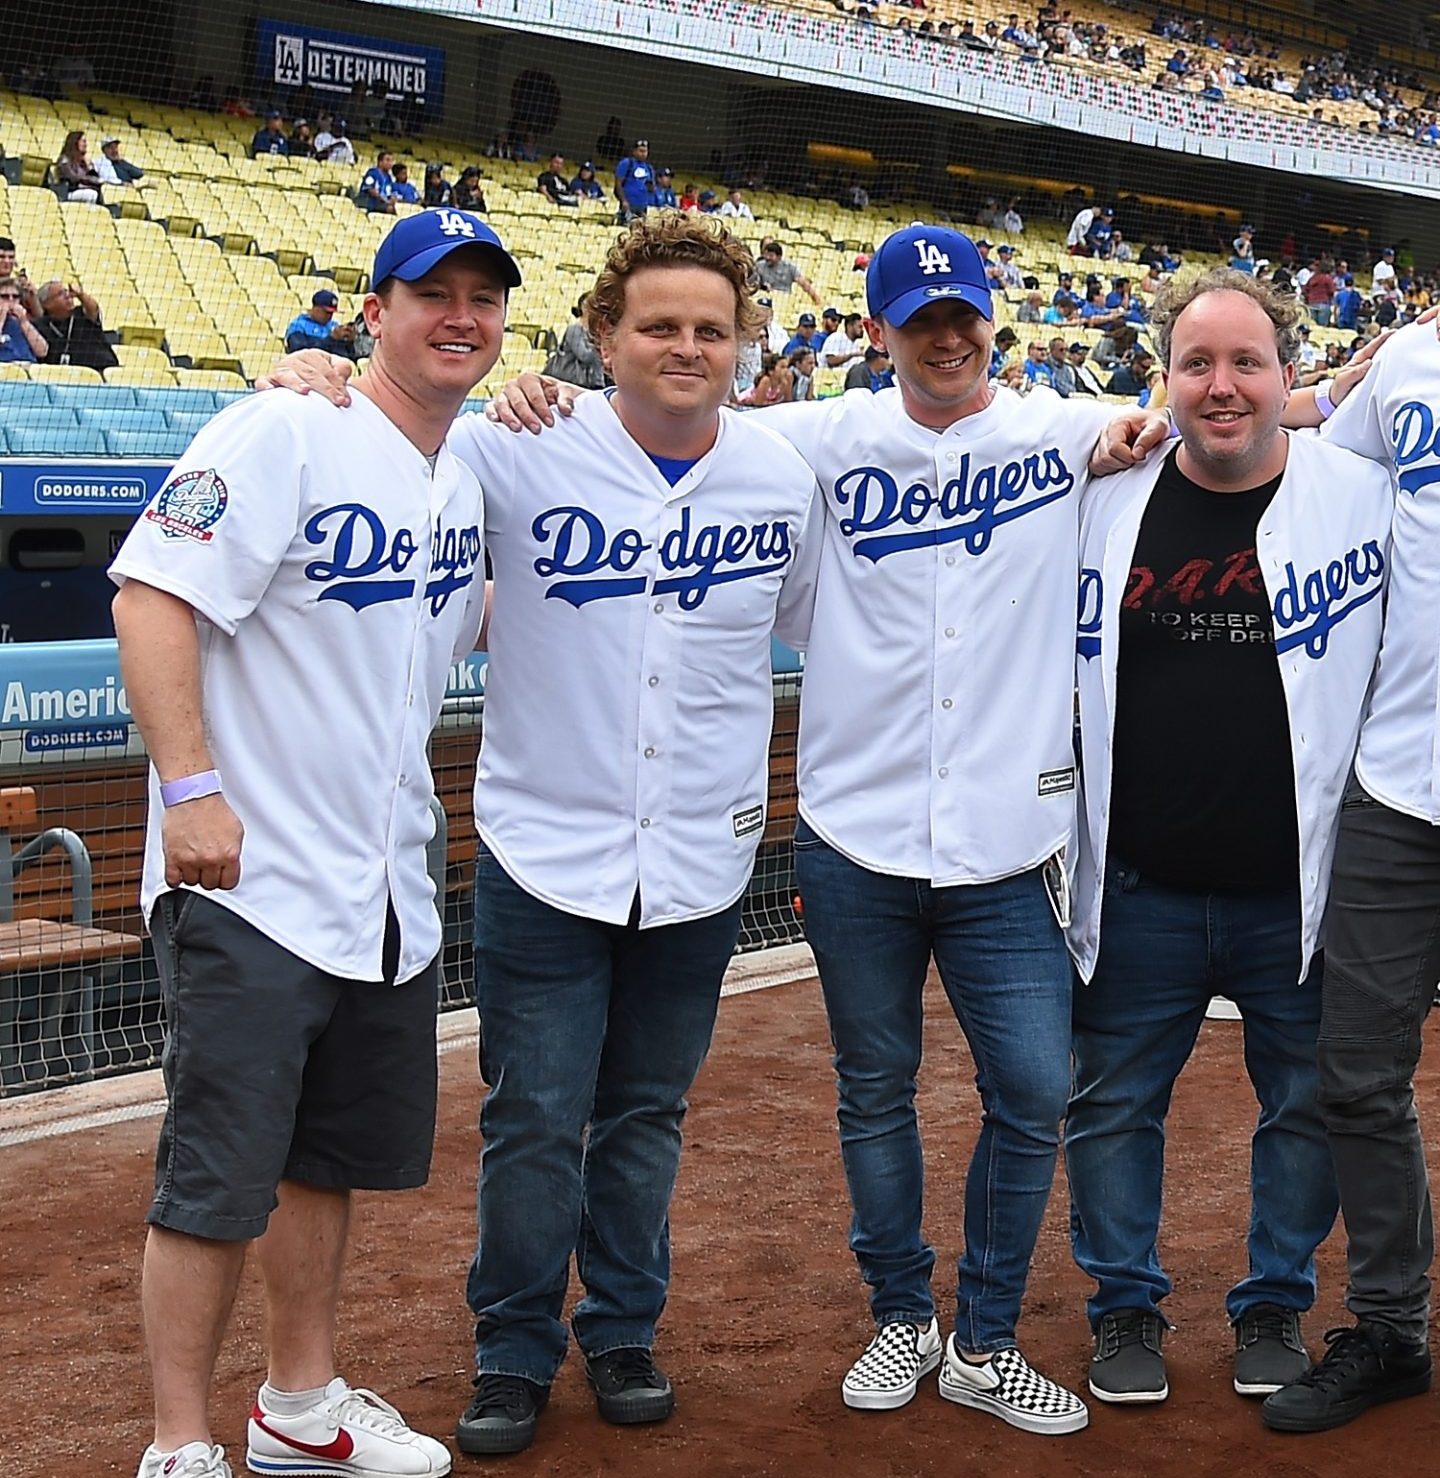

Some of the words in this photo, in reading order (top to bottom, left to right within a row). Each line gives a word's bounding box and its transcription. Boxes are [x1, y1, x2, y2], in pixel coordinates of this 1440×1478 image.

[307, 50, 426, 93] DETERMINED
[435, 209, 475, 238] LA
[913, 239, 951, 275] LA
[42, 483, 140, 498] DODGERS.COM
[834, 448, 1075, 564] Dodgers
[532, 506, 792, 612] Dodgers
[1190, 612, 1261, 628] KEEP
[1, 676, 131, 723] Americ
[31, 731, 124, 748] DODGERS.COM
